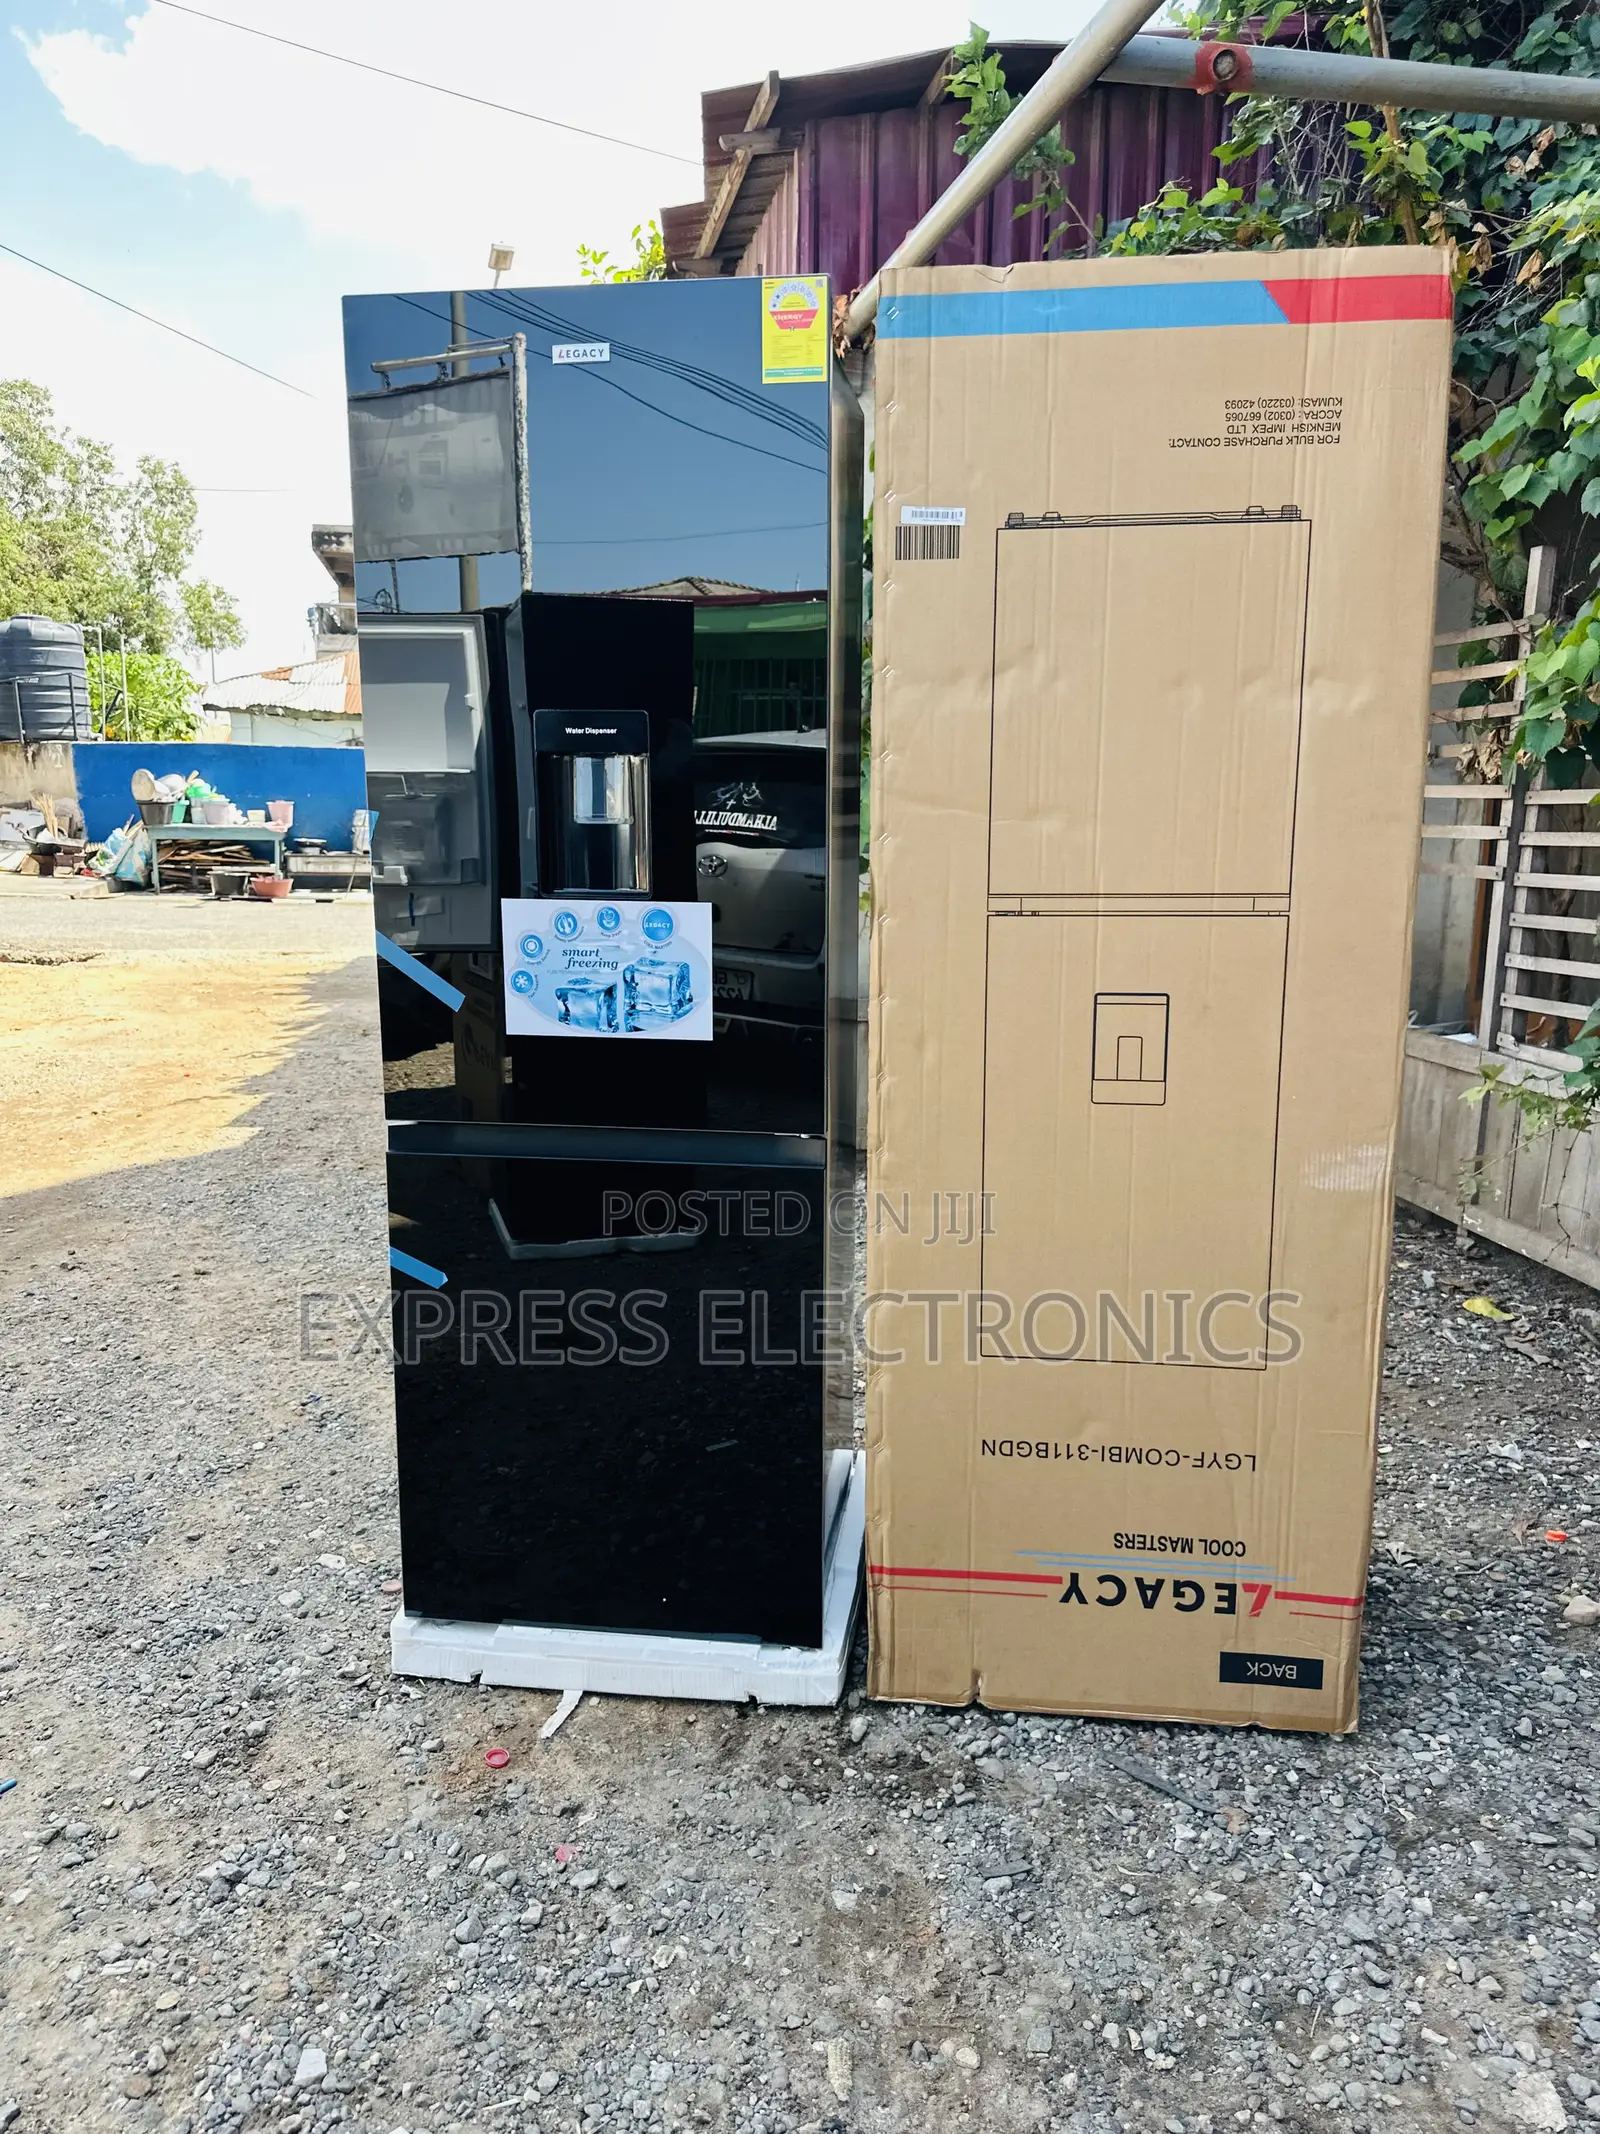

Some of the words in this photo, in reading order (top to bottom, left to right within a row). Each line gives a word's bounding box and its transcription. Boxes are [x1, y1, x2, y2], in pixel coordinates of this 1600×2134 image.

[558, 348, 604, 359] LEGACY
[1224, 399, 1256, 410] 42093
[1257, 396, 1295, 409] (03220)
[1298, 397, 1343, 407] KUMASI:
[1225, 411, 1262, 422] 667065
[1263, 409, 1296, 421] (0302)
[1226, 424, 1247, 435] LTD
[1251, 423, 1286, 433] IMPEX
[1291, 421, 1341, 433] MENKISH
[1168, 437, 1221, 448] CONTACT:
[1223, 435, 1284, 447] PURCHASE
[1285, 434, 1314, 445] BULK
[1317, 434, 1341, 445] FOR
[585, 727, 618, 735] Dispenser
[562, 948, 600, 957] smart
[564, 957, 619, 971] freezing
[980, 1438, 1258, 1472] LGYF-COMBI-311BGDN
[1113, 1531, 1194, 1555] MASTERS
[1198, 1538, 1247, 1558] COOL
[1058, 1571, 1274, 1618] LEGACY
[1246, 1661, 1298, 1680] BACK
